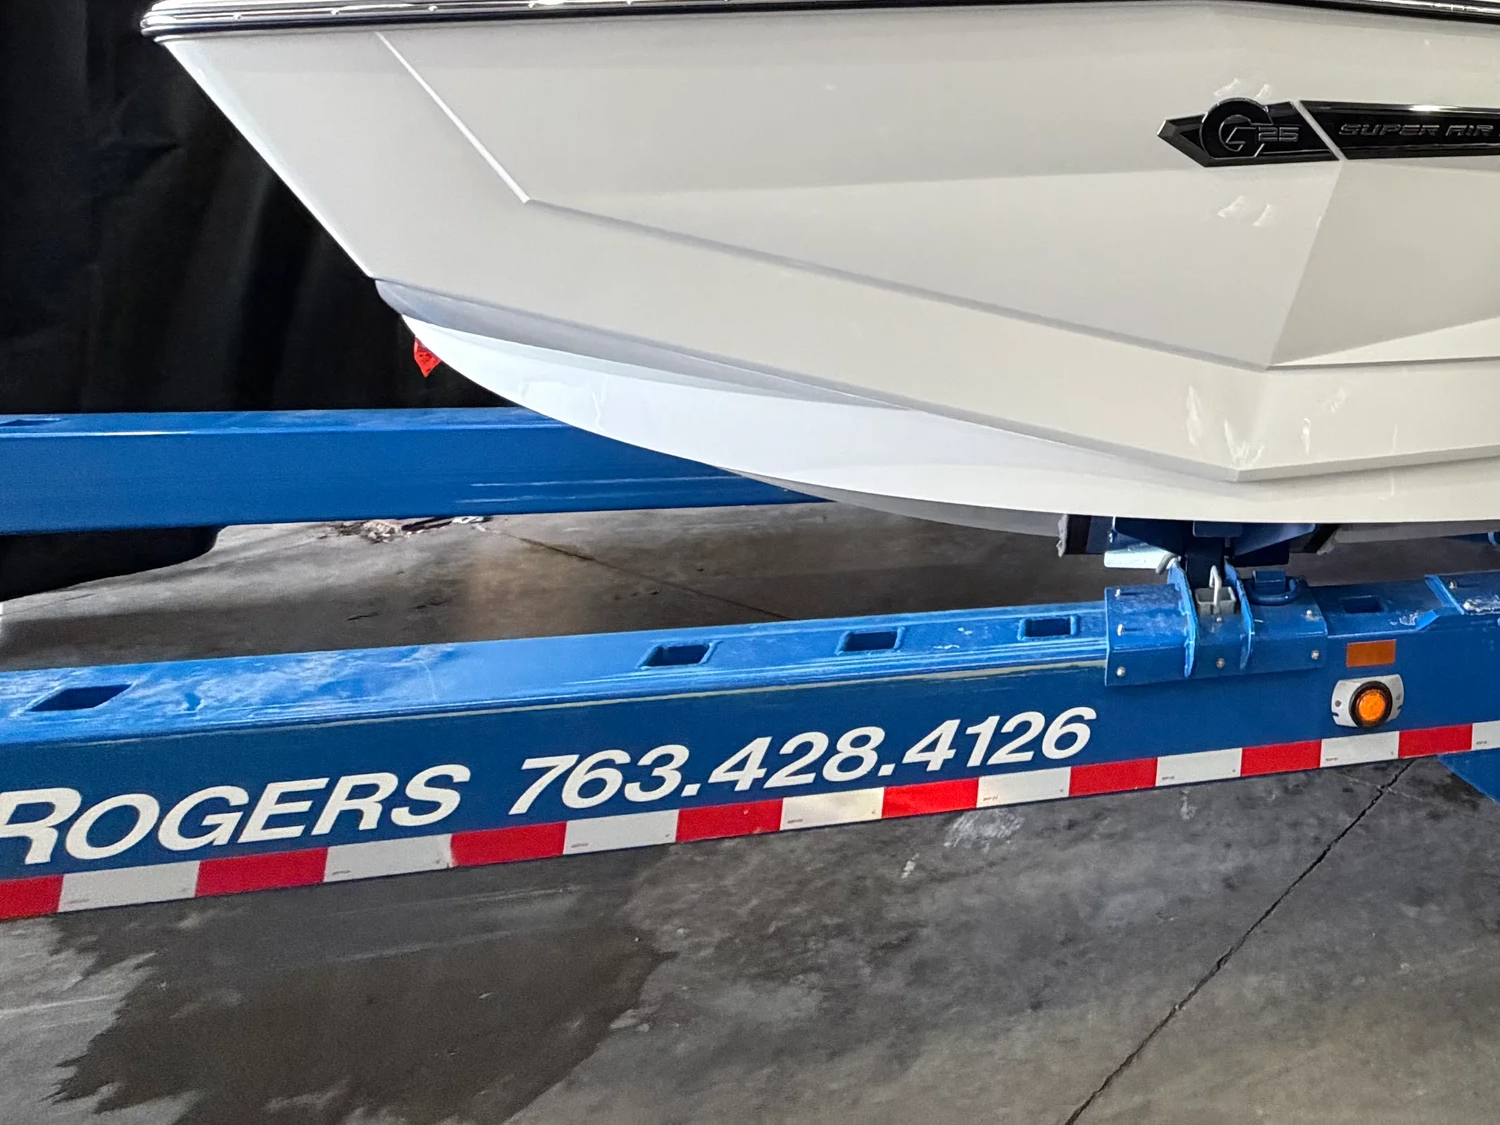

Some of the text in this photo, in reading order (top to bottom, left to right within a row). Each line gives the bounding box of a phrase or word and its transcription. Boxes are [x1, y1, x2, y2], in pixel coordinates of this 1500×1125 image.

[1338, 122, 1441, 137] SUPER
[1444, 123, 1495, 138] AIR
[0, 705, 1097, 865] ROGERS 763.428.4126
